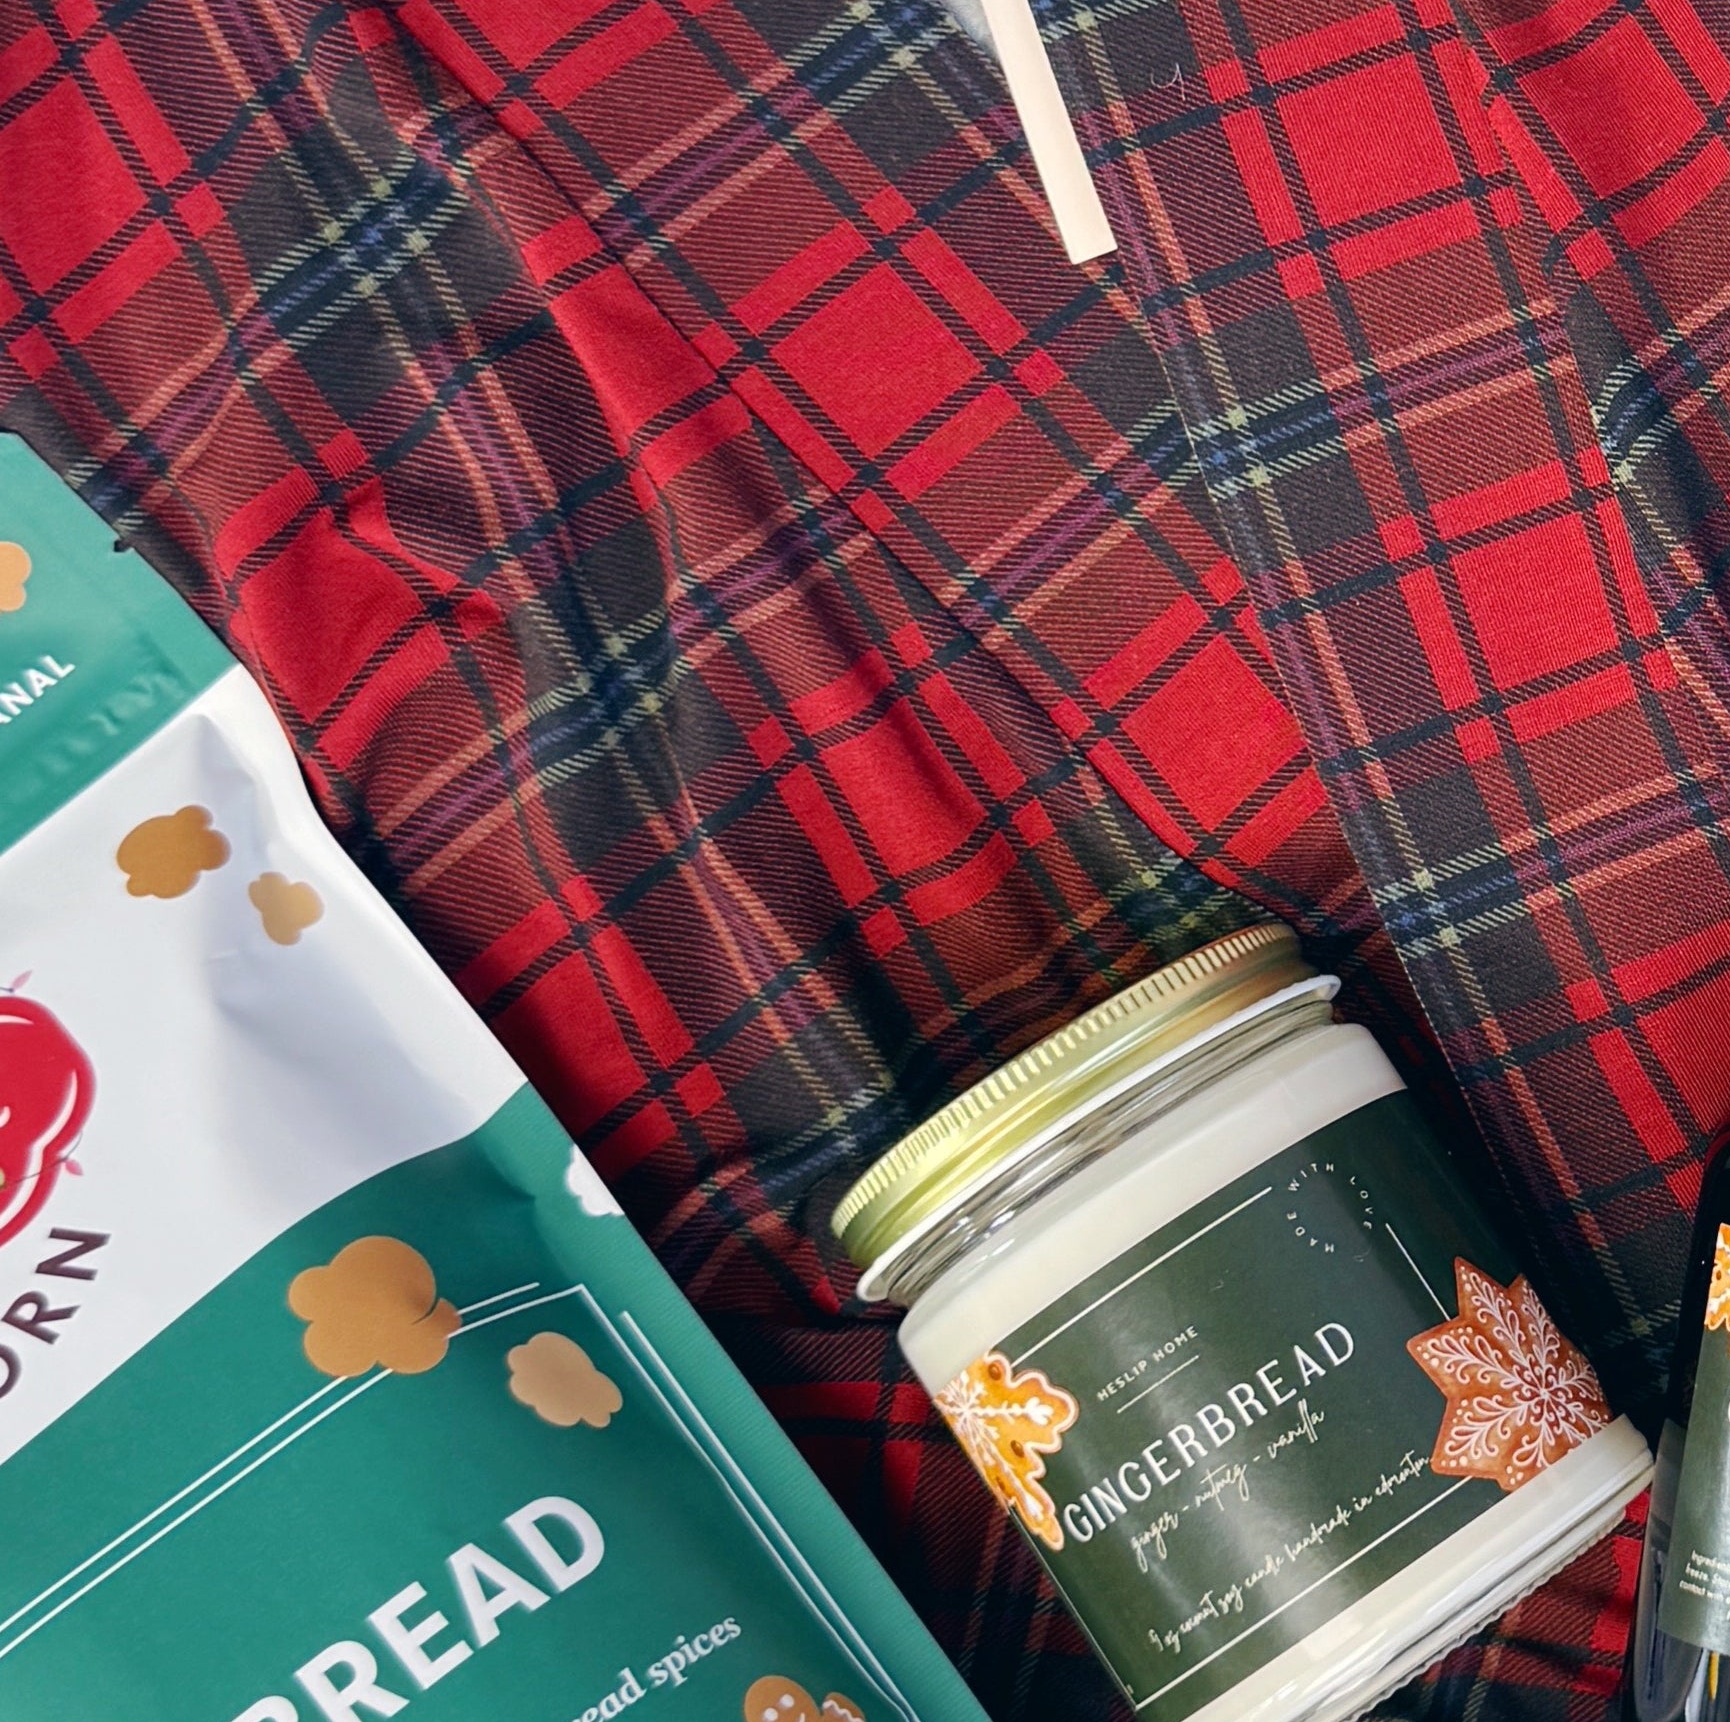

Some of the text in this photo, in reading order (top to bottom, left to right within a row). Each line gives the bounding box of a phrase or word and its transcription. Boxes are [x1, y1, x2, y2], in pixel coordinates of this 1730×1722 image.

[0, 655, 76, 724] NAL
[1286, 1163, 1374, 1253] MADE WITH LOVE
[1096, 1325, 1199, 1402] HESLIP HOME
[1063, 1322, 1354, 1543] GINGERBREAD
[1129, 1511, 1179, 1574] ginger
[1194, 1462, 1250, 1512] nutmeg
[1266, 1397, 1325, 1459] vanilla
[1216, 1583, 1244, 1615] soy
[1244, 1554, 1285, 1589] candle
[1351, 1496, 1374, 1512] in
[645, 1616, 742, 1688] spices
